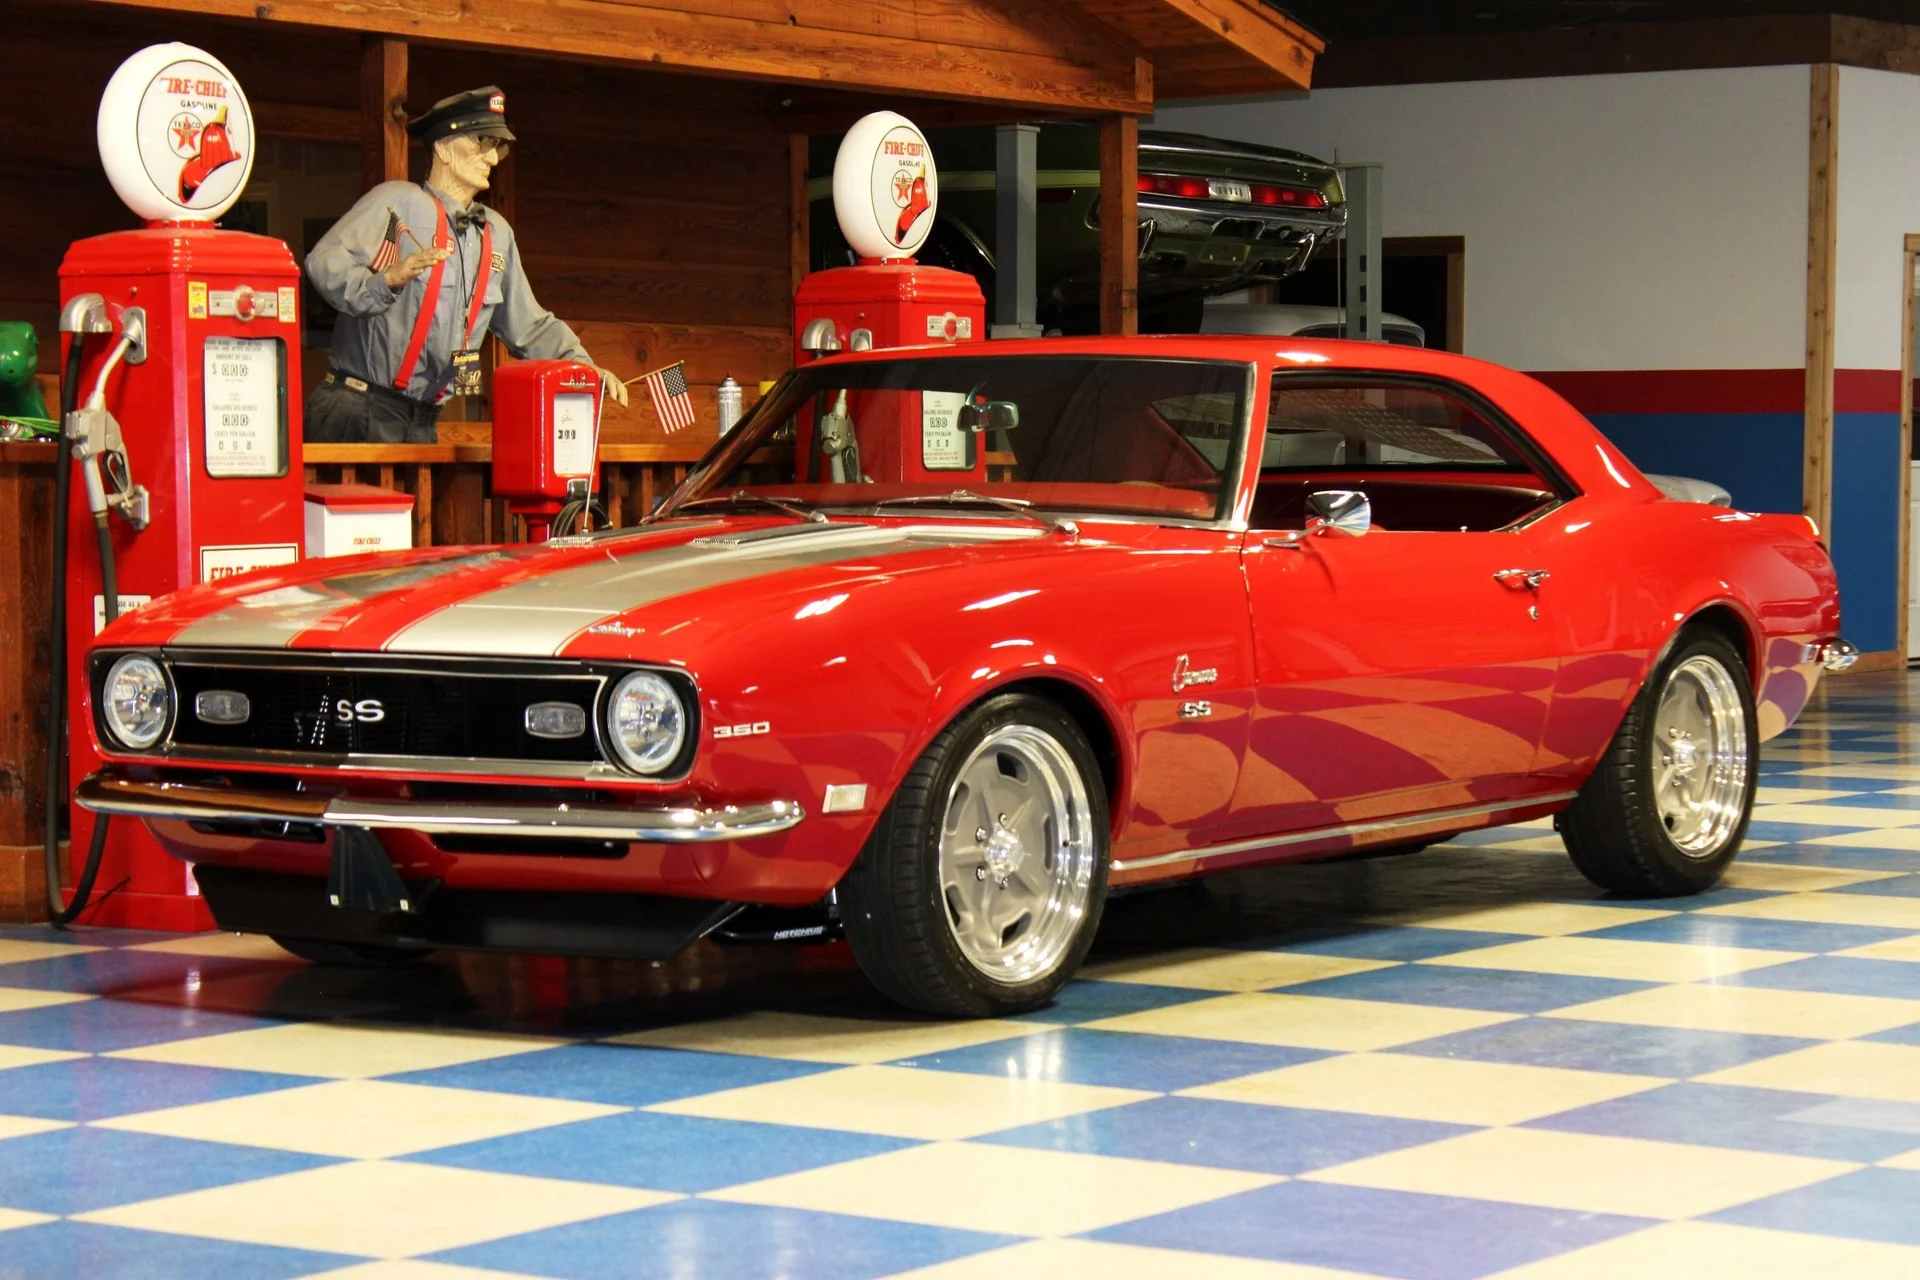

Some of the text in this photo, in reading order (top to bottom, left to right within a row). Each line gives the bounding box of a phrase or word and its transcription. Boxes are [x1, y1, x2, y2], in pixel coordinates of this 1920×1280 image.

[160, 77, 228, 98] IRE-CHIEF
[173, 121, 201, 129] TEXACO
[336, 699, 385, 722] SS
[1182, 700, 1212, 718] SS
[713, 721, 770, 739] 350
